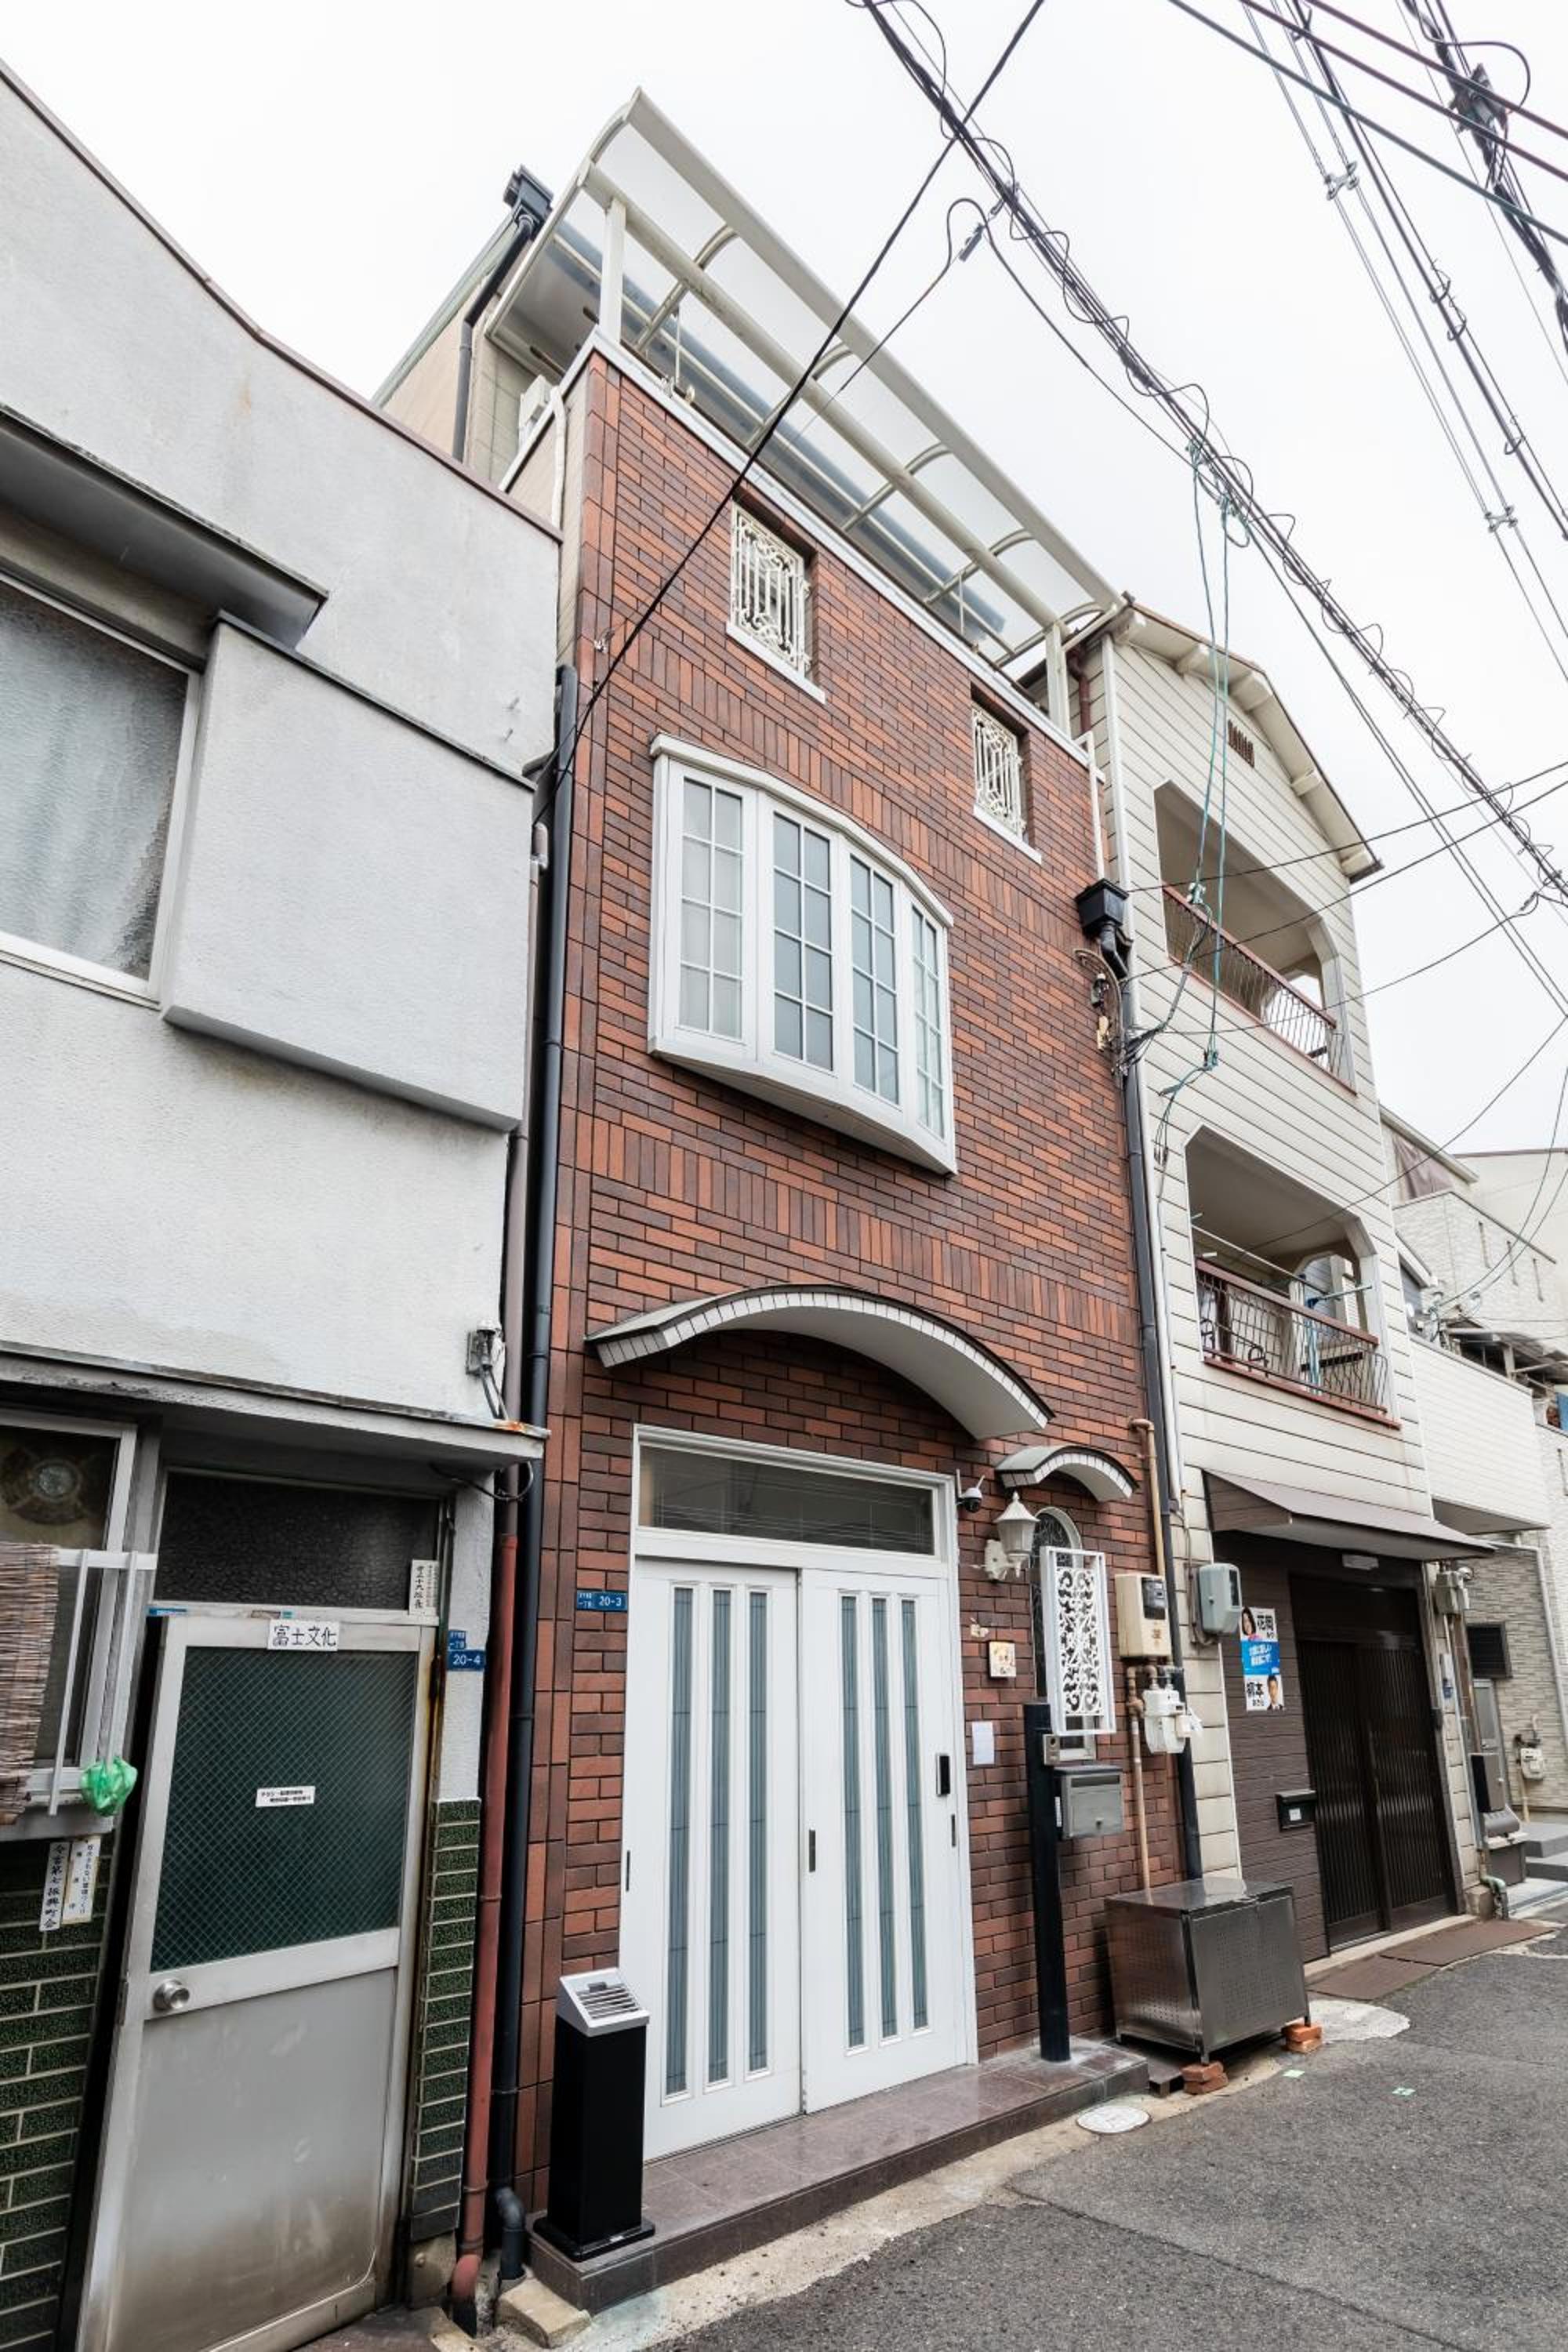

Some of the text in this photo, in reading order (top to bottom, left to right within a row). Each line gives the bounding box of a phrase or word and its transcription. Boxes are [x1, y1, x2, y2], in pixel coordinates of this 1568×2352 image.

[599, 1595, 622, 1606] 20-3
[273, 1624, 336, 1646] 富士文化
[452, 1653, 481, 1665] 20-4
